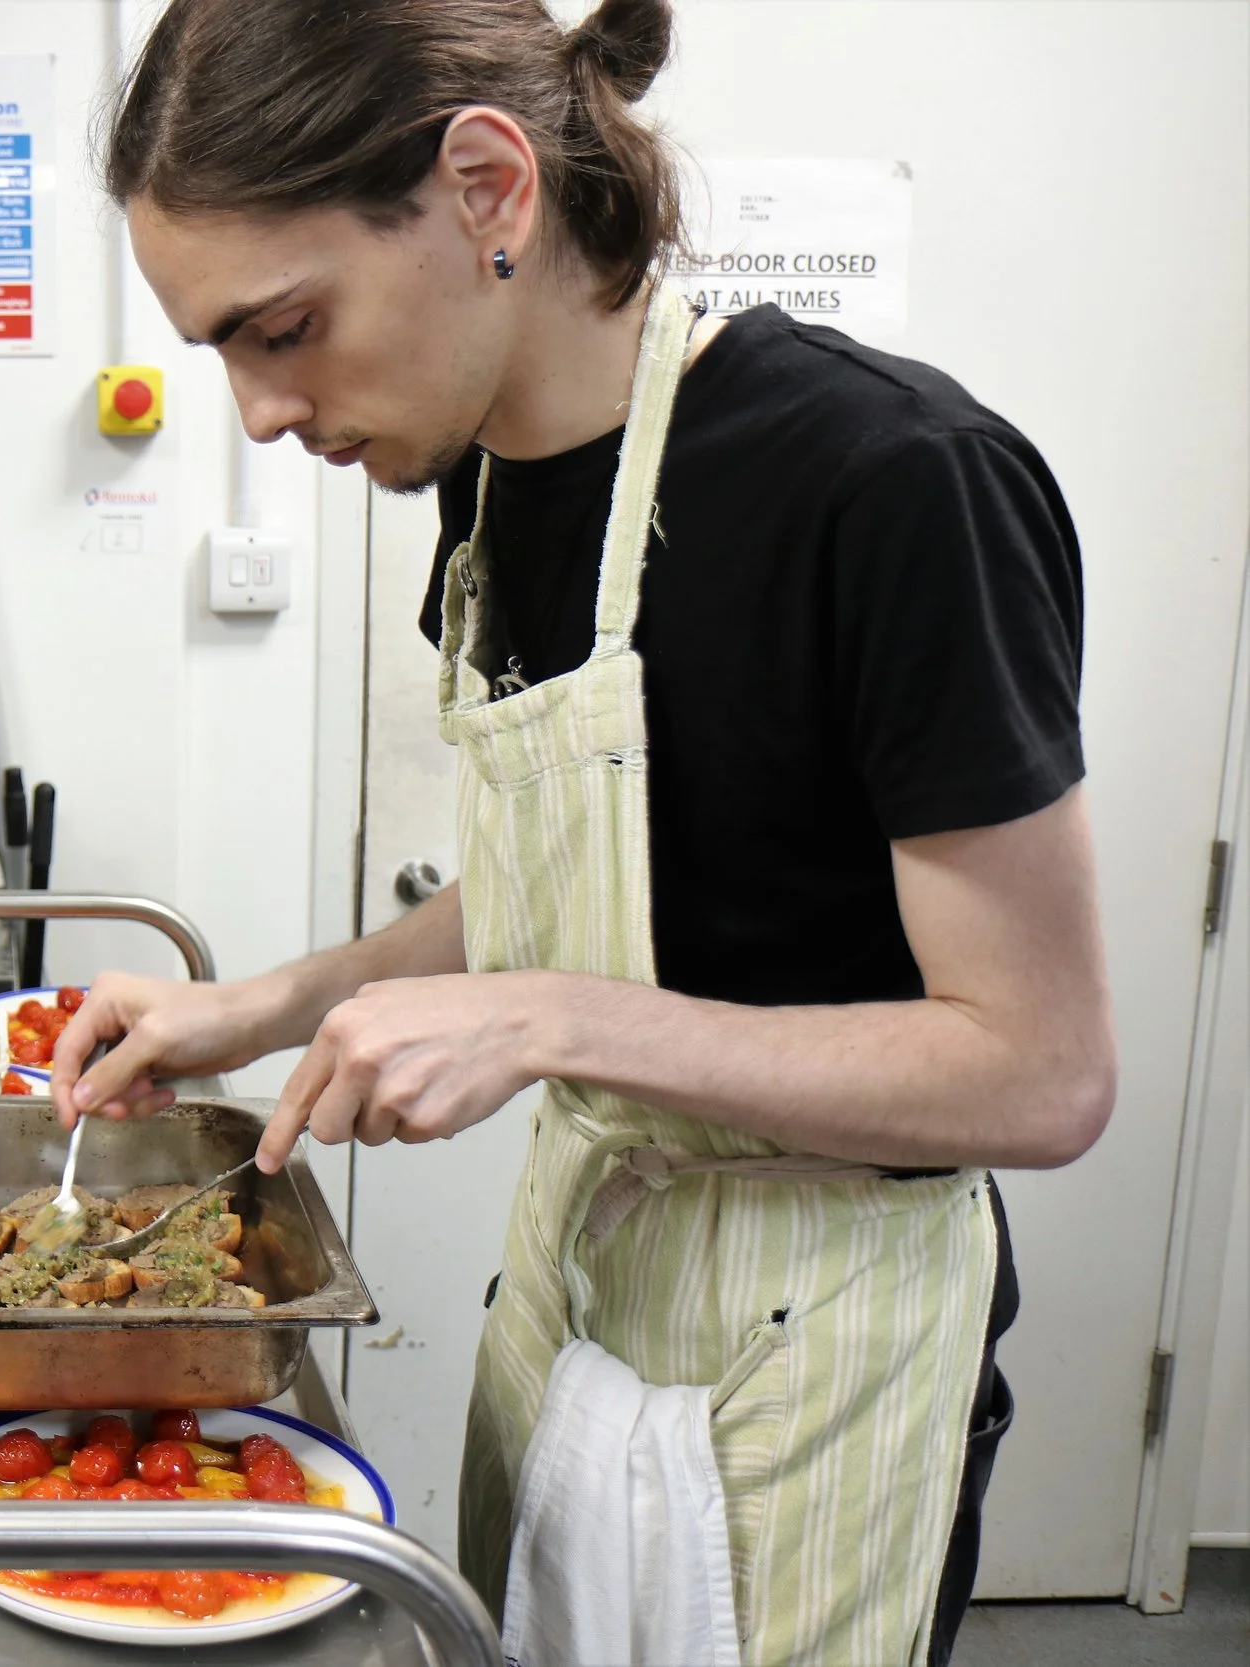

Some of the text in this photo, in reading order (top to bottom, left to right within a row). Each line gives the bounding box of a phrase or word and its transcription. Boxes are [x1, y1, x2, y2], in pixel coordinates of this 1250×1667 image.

[720, 253, 786, 273] DOOR
[792, 253, 877, 274] CLOSED
[696, 289, 722, 307] AT
[773, 289, 841, 309] TIMES
